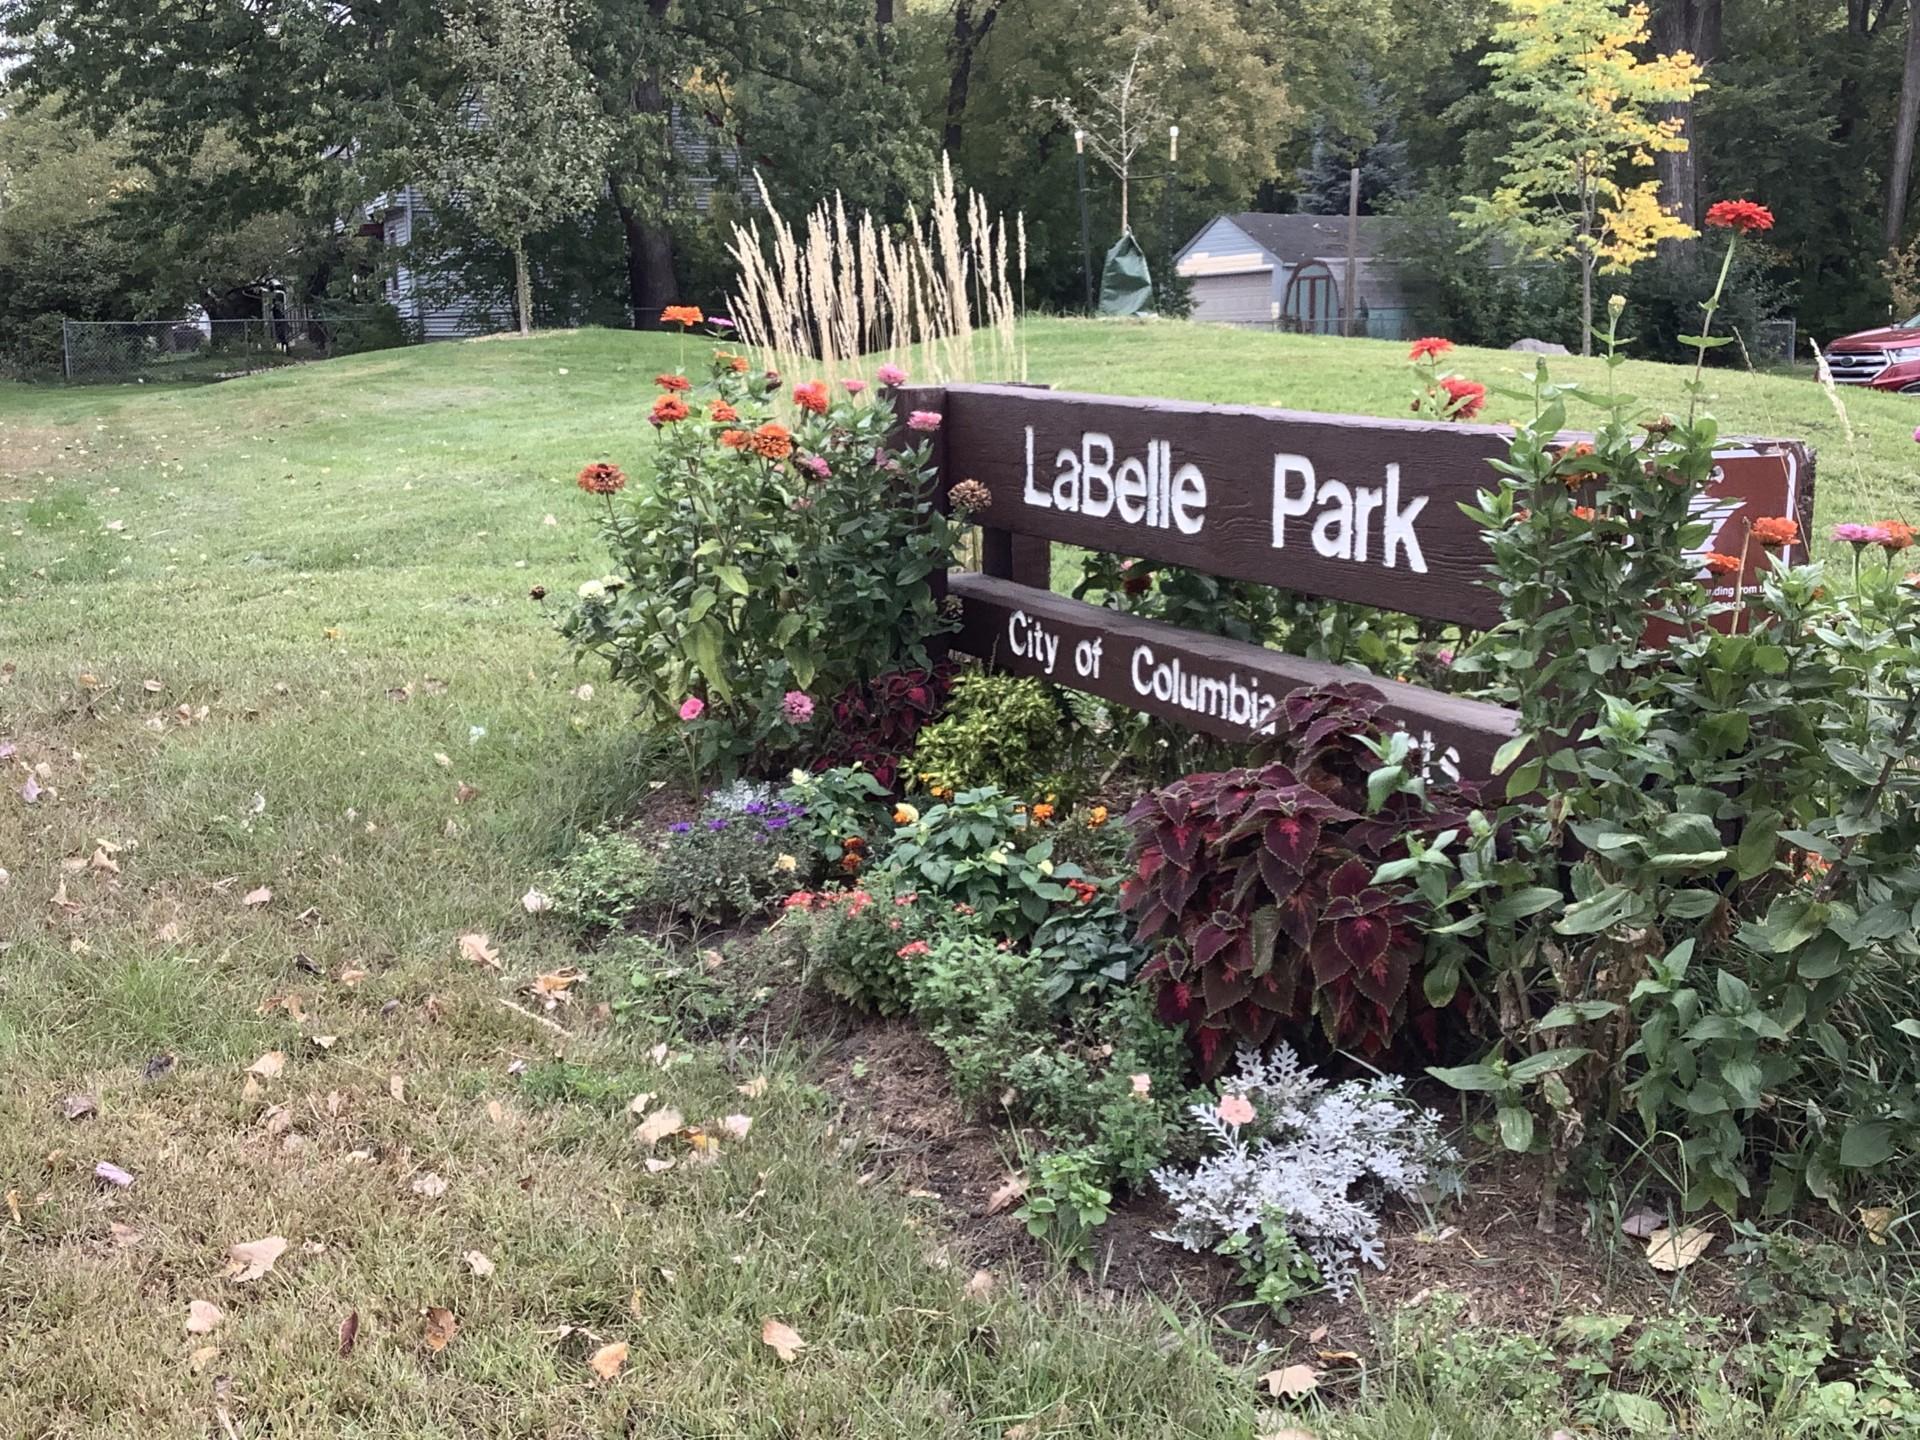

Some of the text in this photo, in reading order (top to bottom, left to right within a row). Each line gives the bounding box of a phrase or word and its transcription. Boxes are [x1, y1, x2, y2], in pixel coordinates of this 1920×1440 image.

[1024, 425, 1430, 573] LaBelle Park
[1738, 586, 1757, 594] rom
[1008, 609, 1059, 674] City
[1075, 636, 1103, 679] of
